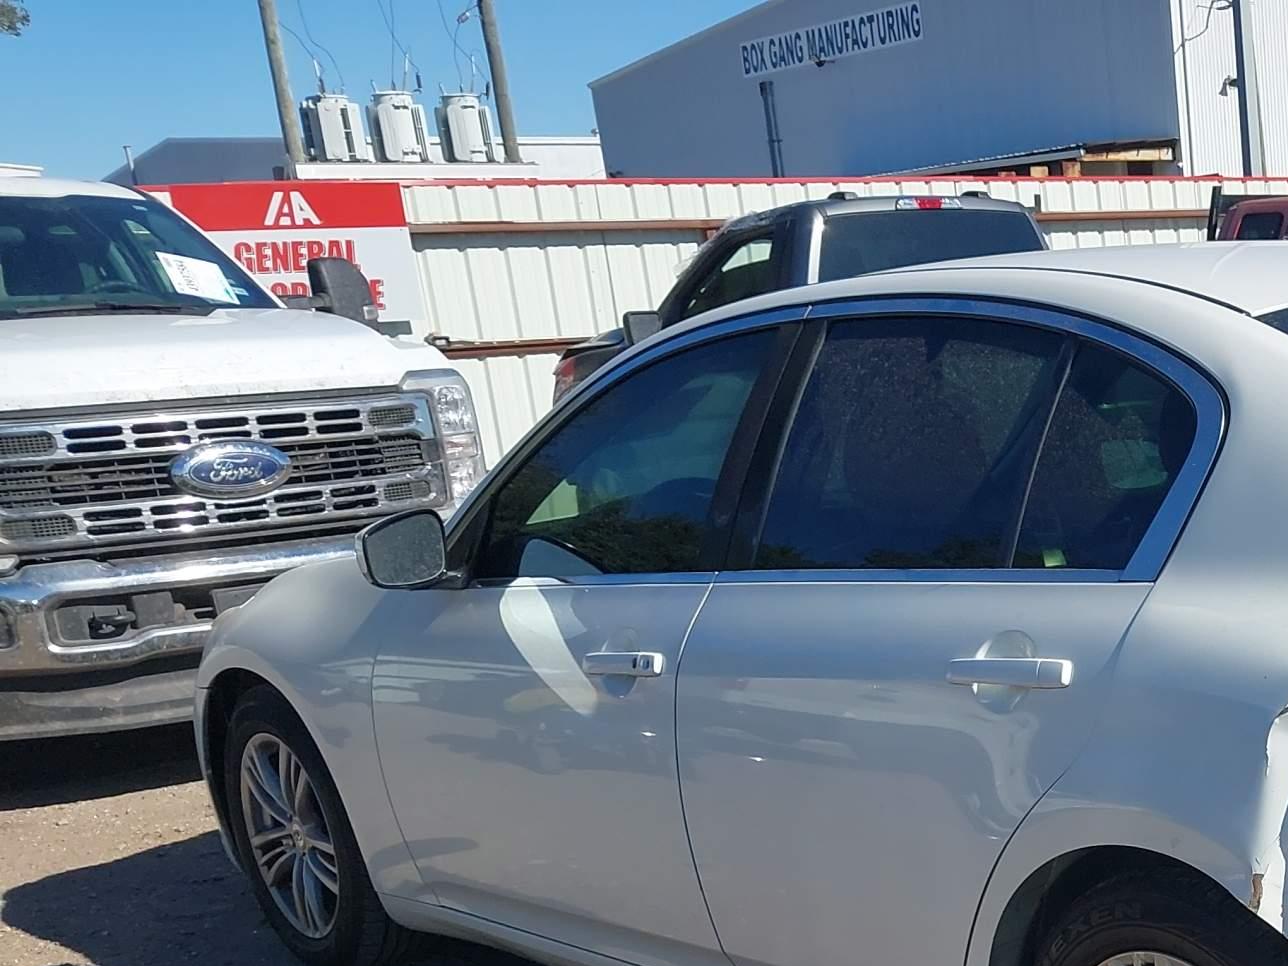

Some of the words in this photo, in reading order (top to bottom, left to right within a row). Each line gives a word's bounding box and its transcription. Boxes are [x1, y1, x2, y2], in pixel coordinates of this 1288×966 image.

[742, 41, 768, 75] BOX
[768, 32, 804, 69] GANG
[805, 3, 922, 58] MANUFACTURING
[210, 458, 264, 482] Ford
